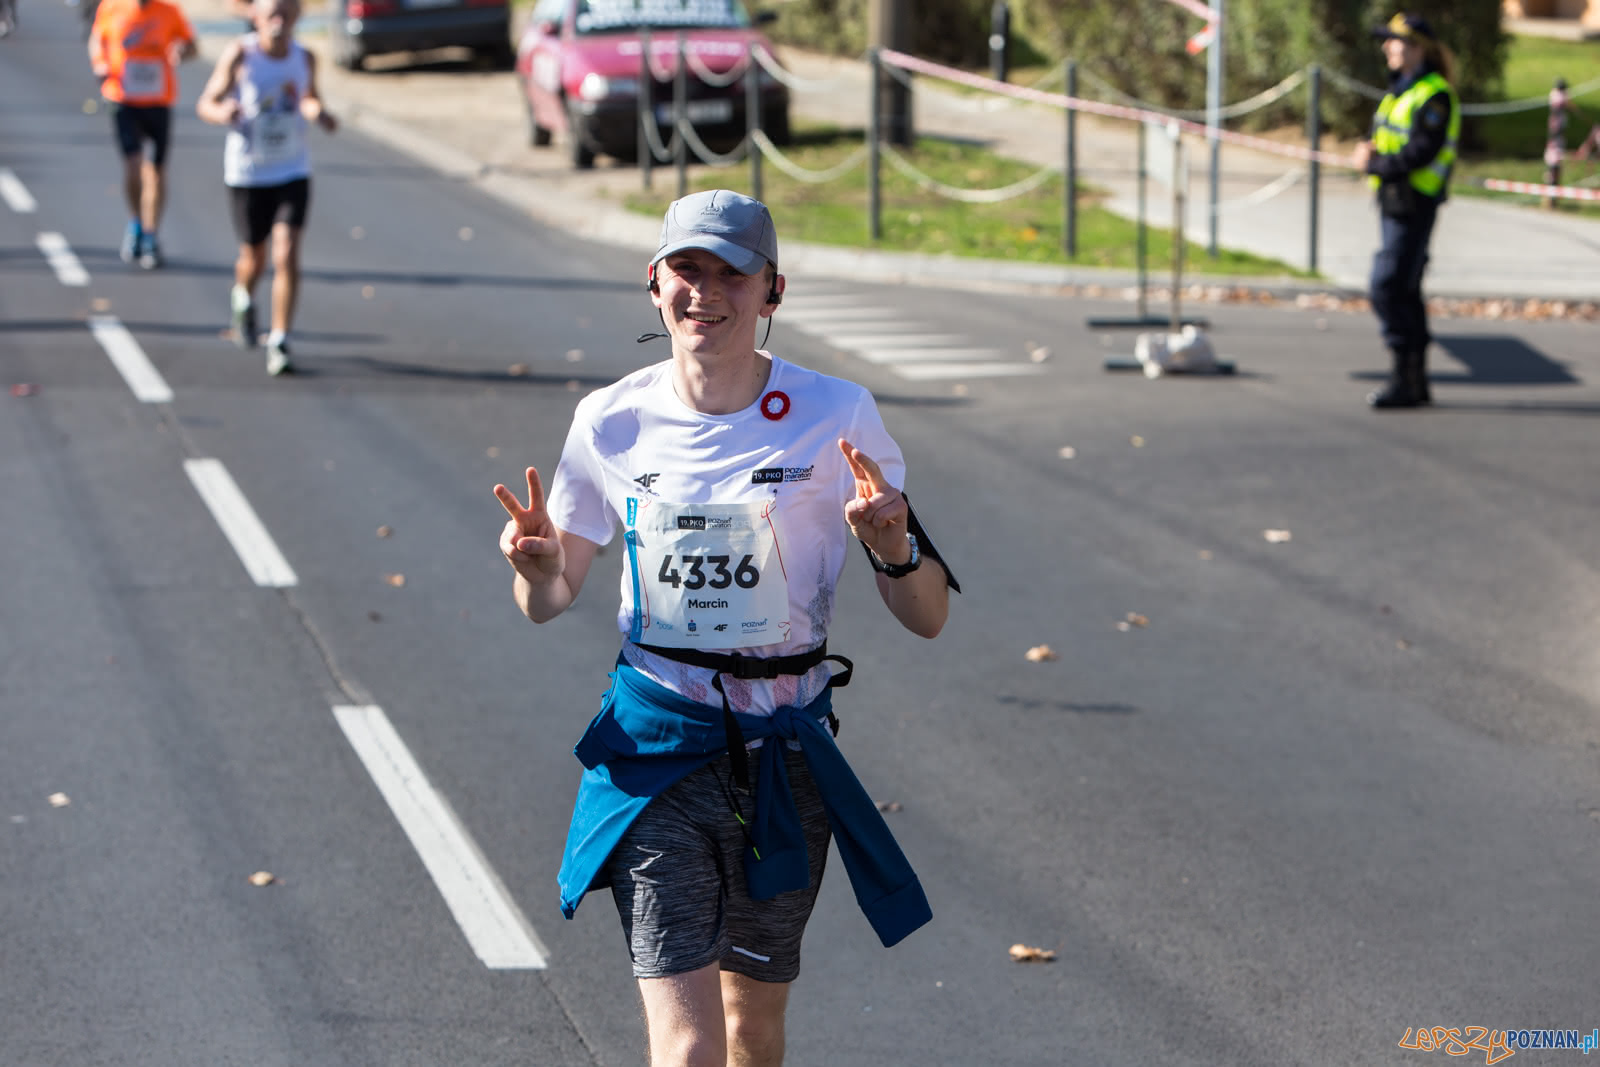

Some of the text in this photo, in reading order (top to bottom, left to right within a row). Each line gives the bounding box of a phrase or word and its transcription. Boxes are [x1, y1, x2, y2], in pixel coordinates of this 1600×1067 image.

[766, 472, 782, 480] PKO
[689, 519, 704, 527] PKO
[658, 554, 760, 590] 4336
[688, 599, 729, 609] Marcin
